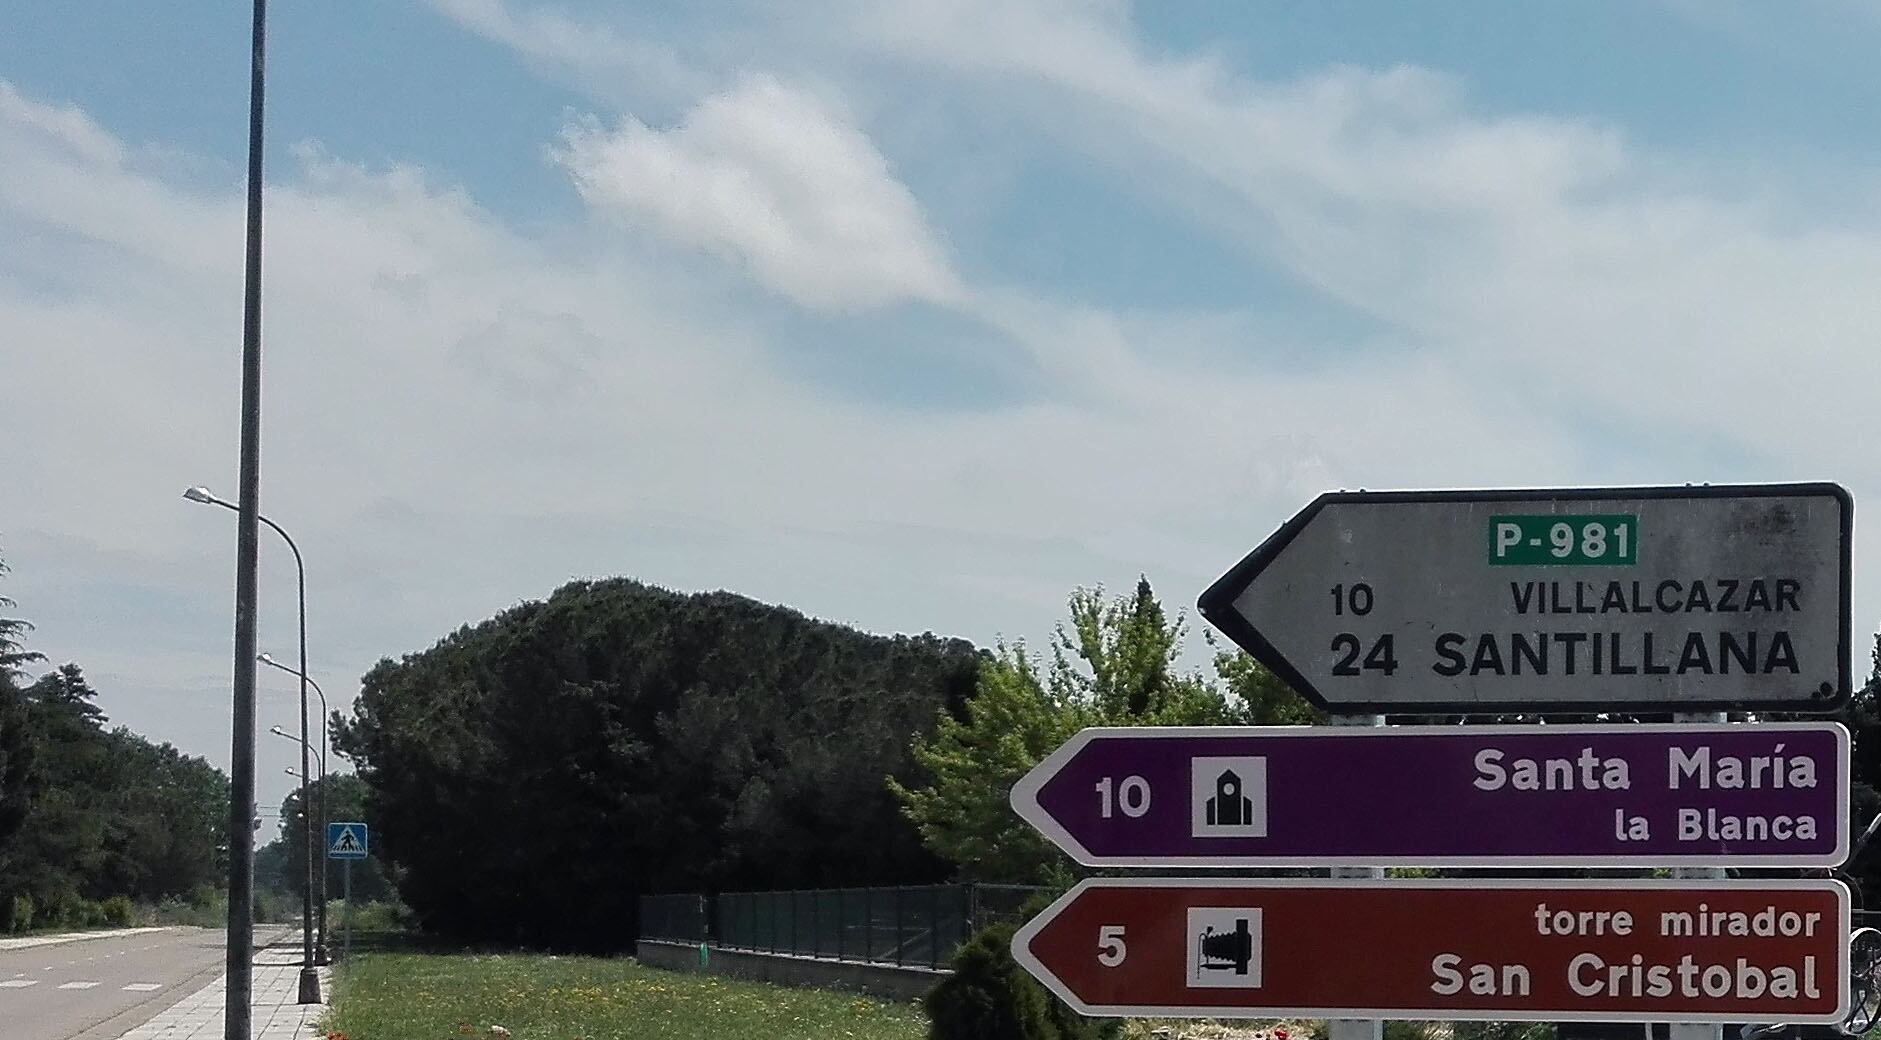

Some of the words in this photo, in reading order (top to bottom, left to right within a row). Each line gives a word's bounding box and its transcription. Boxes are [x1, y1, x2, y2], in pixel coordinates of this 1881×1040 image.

[1496, 522, 1628, 558] P-981
[1330, 582, 1374, 617] 10
[1510, 578, 1802, 615] VILLALCAZAR
[1330, 632, 1399, 676] 24
[1432, 631, 1801, 676] SANTILLANA
[1472, 747, 1631, 791] Santa
[1668, 743, 1818, 790] María
[1095, 775, 1152, 818] 10
[1615, 808, 1650, 841] la
[1678, 807, 1817, 841] Blanca
[1534, 903, 1633, 936] torre
[1660, 903, 1821, 937] mirador
[1097, 925, 1127, 967] 5
[1430, 953, 1530, 996] San
[1567, 952, 1821, 999] Cristobal
